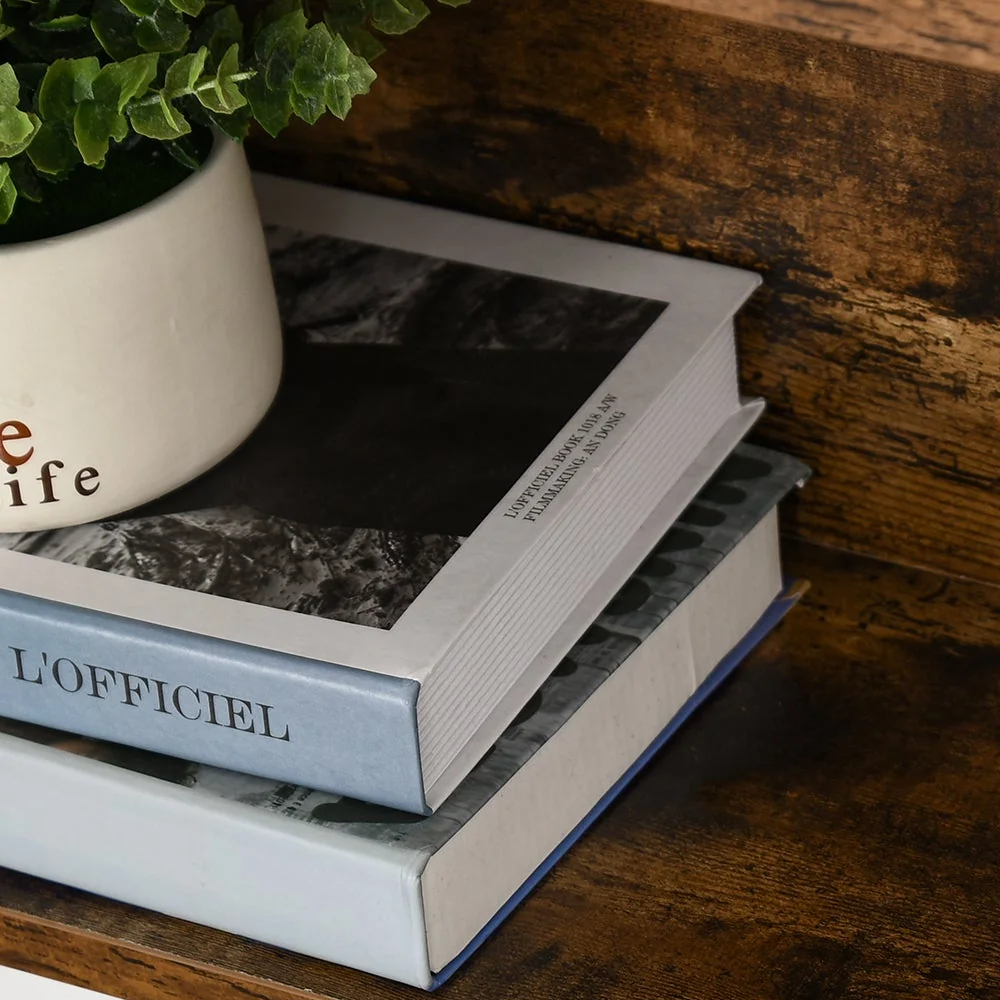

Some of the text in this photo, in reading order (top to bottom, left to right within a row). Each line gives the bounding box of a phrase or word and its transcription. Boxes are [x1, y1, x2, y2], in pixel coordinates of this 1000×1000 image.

[504, 463, 559, 519] L'OFFICIEL
[552, 434, 584, 463] BOOK
[523, 411, 627, 522] FILMMAKING: AN DONG
[8, 646, 291, 742] L'OFFICIEL
